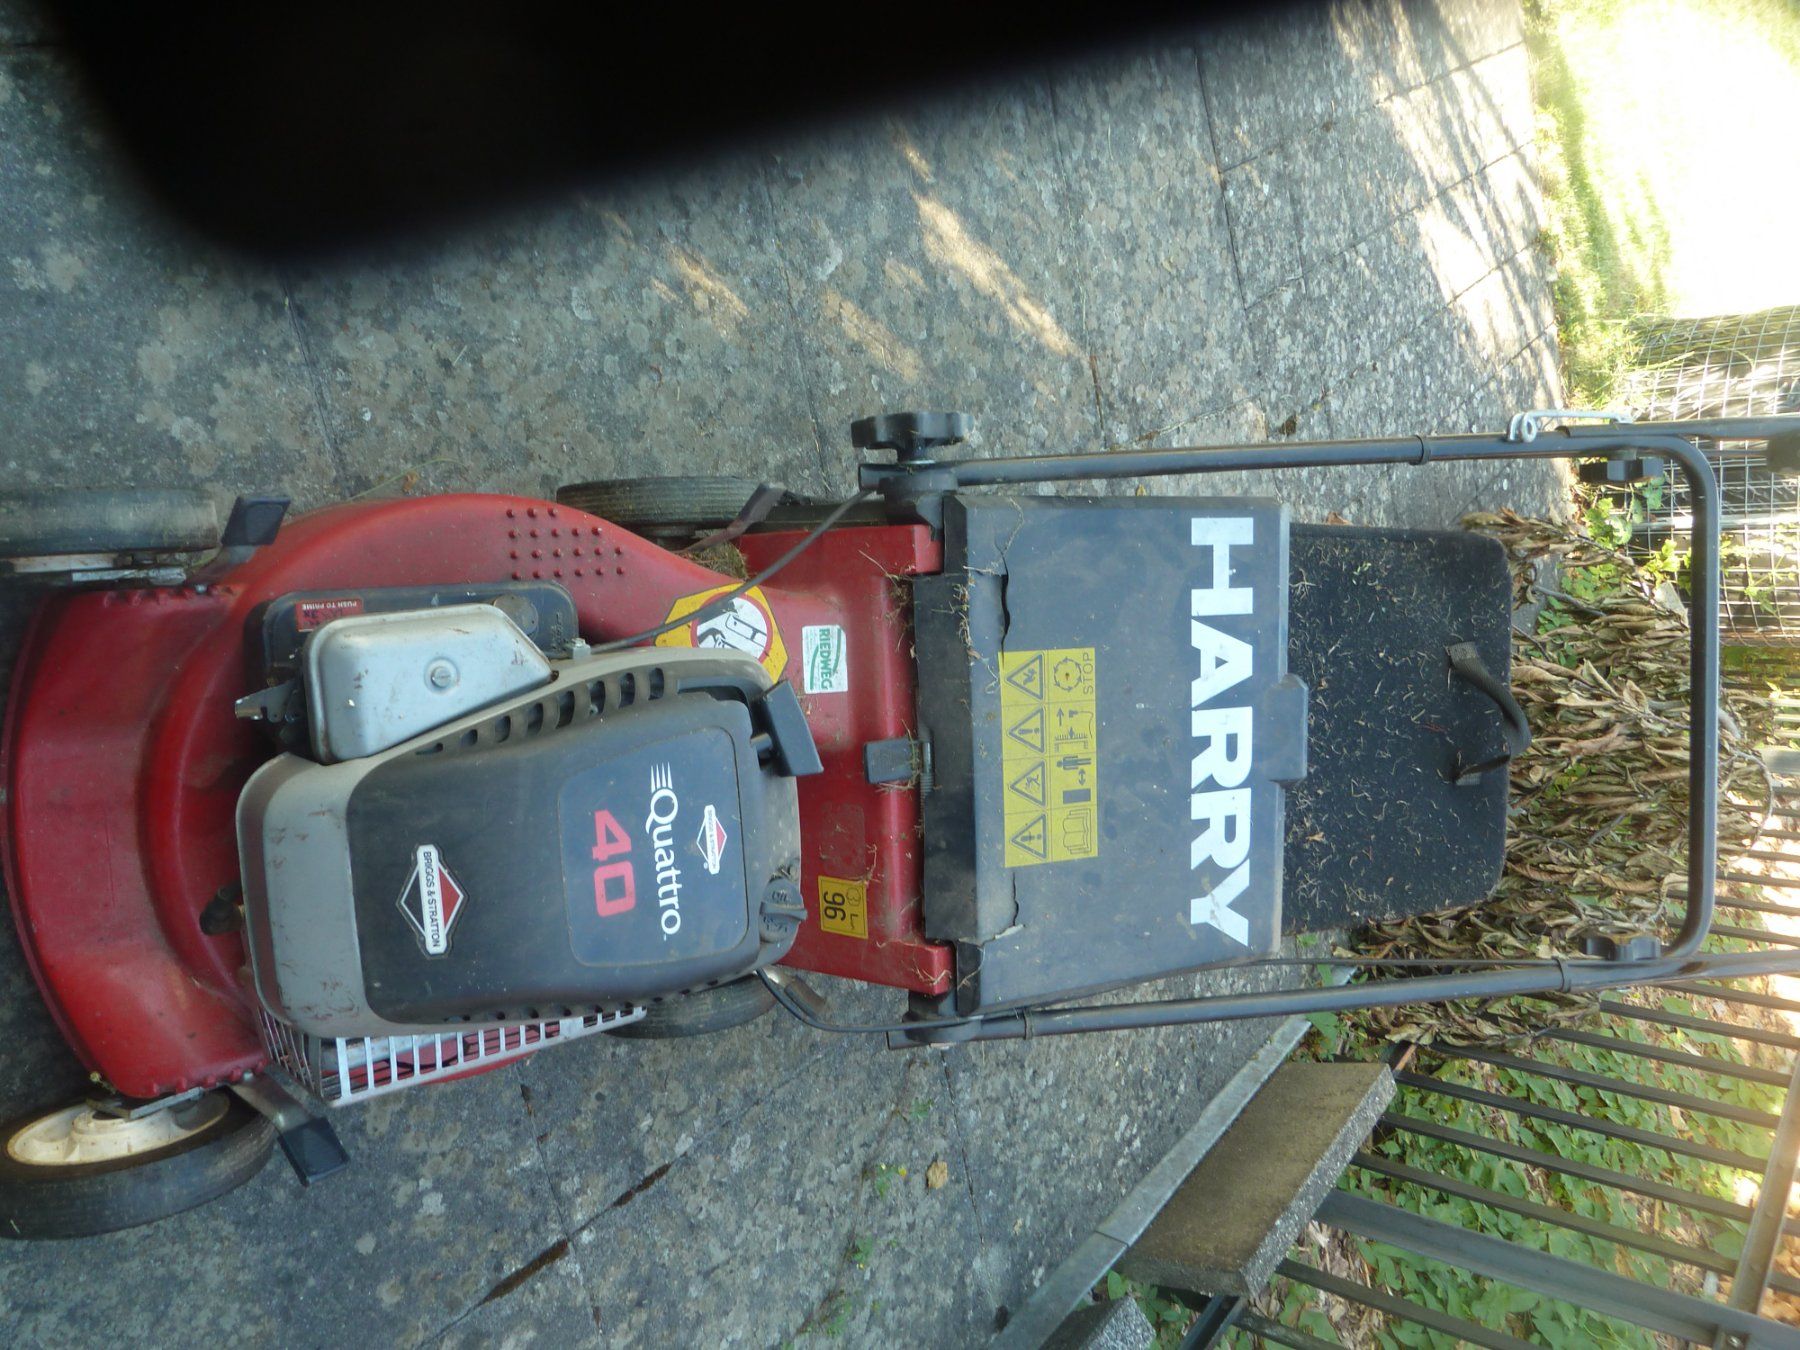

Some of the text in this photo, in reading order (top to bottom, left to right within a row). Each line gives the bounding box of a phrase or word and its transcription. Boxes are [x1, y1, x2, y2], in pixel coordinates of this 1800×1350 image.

[819, 628, 833, 690] RIEDWEG
[1083, 652, 1093, 694] STOP
[1191, 517, 1254, 947] HARRY
[423, 851, 435, 888] BRIGGS
[592, 809, 636, 917] 40
[645, 788, 683, 935] Quattro
[428, 899, 441, 947] STRATTON
[823, 891, 847, 921] 96
